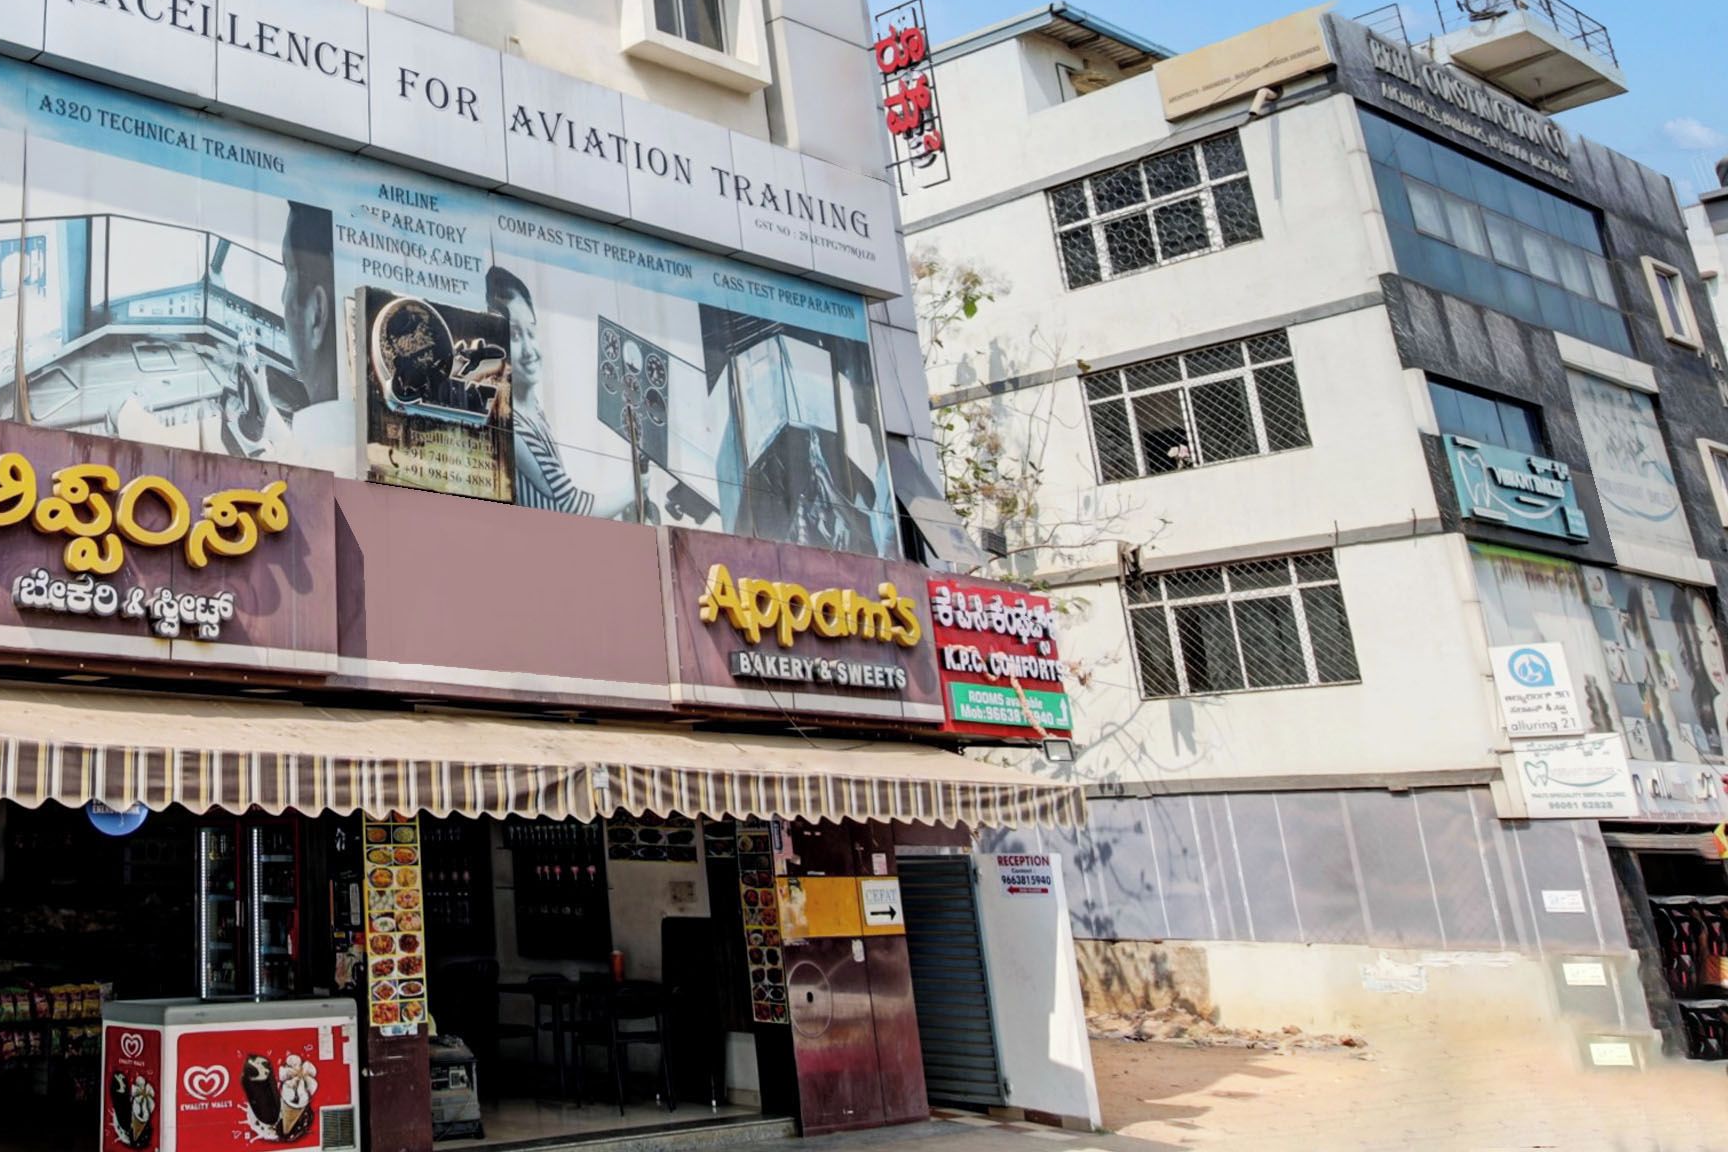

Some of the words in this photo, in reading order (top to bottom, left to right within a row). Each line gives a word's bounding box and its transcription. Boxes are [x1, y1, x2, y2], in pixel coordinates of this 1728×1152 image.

[39, 95, 92, 123] A320
[97, 108, 198, 152] TECHNICAL
[202, 137, 285, 173] TRAINING
[398, 67, 479, 122] FOR
[510, 105, 691, 184] AVIATION
[711, 166, 870, 238] TRAINING
[378, 184, 439, 212] AIRLINE
[755, 219, 772, 231] GST
[497, 215, 563, 245] COMPASS
[566, 232, 601, 254] TEST
[603, 242, 692, 279] PREPARATION
[713, 272, 744, 293] CASS
[747, 282, 775, 301] TEST
[778, 288, 855, 320] PREPARATION
[14, 567, 118, 616] ಬೇಕರಿ
[125, 586, 146, 618] &
[698, 563, 922, 648] Appam's
[736, 650, 813, 682] BAKERY
[818, 658, 833, 681] &
[836, 662, 907, 690] SWEETS
[990, 652, 1066, 682] COMFORTS
[968, 691, 1004, 706] ROOMS
[1511, 720, 1558, 732] alluring
[1561, 718, 1576, 728] 21
[997, 855, 1050, 867] RECEPTION
[1001, 875, 1051, 885] 9663815940
